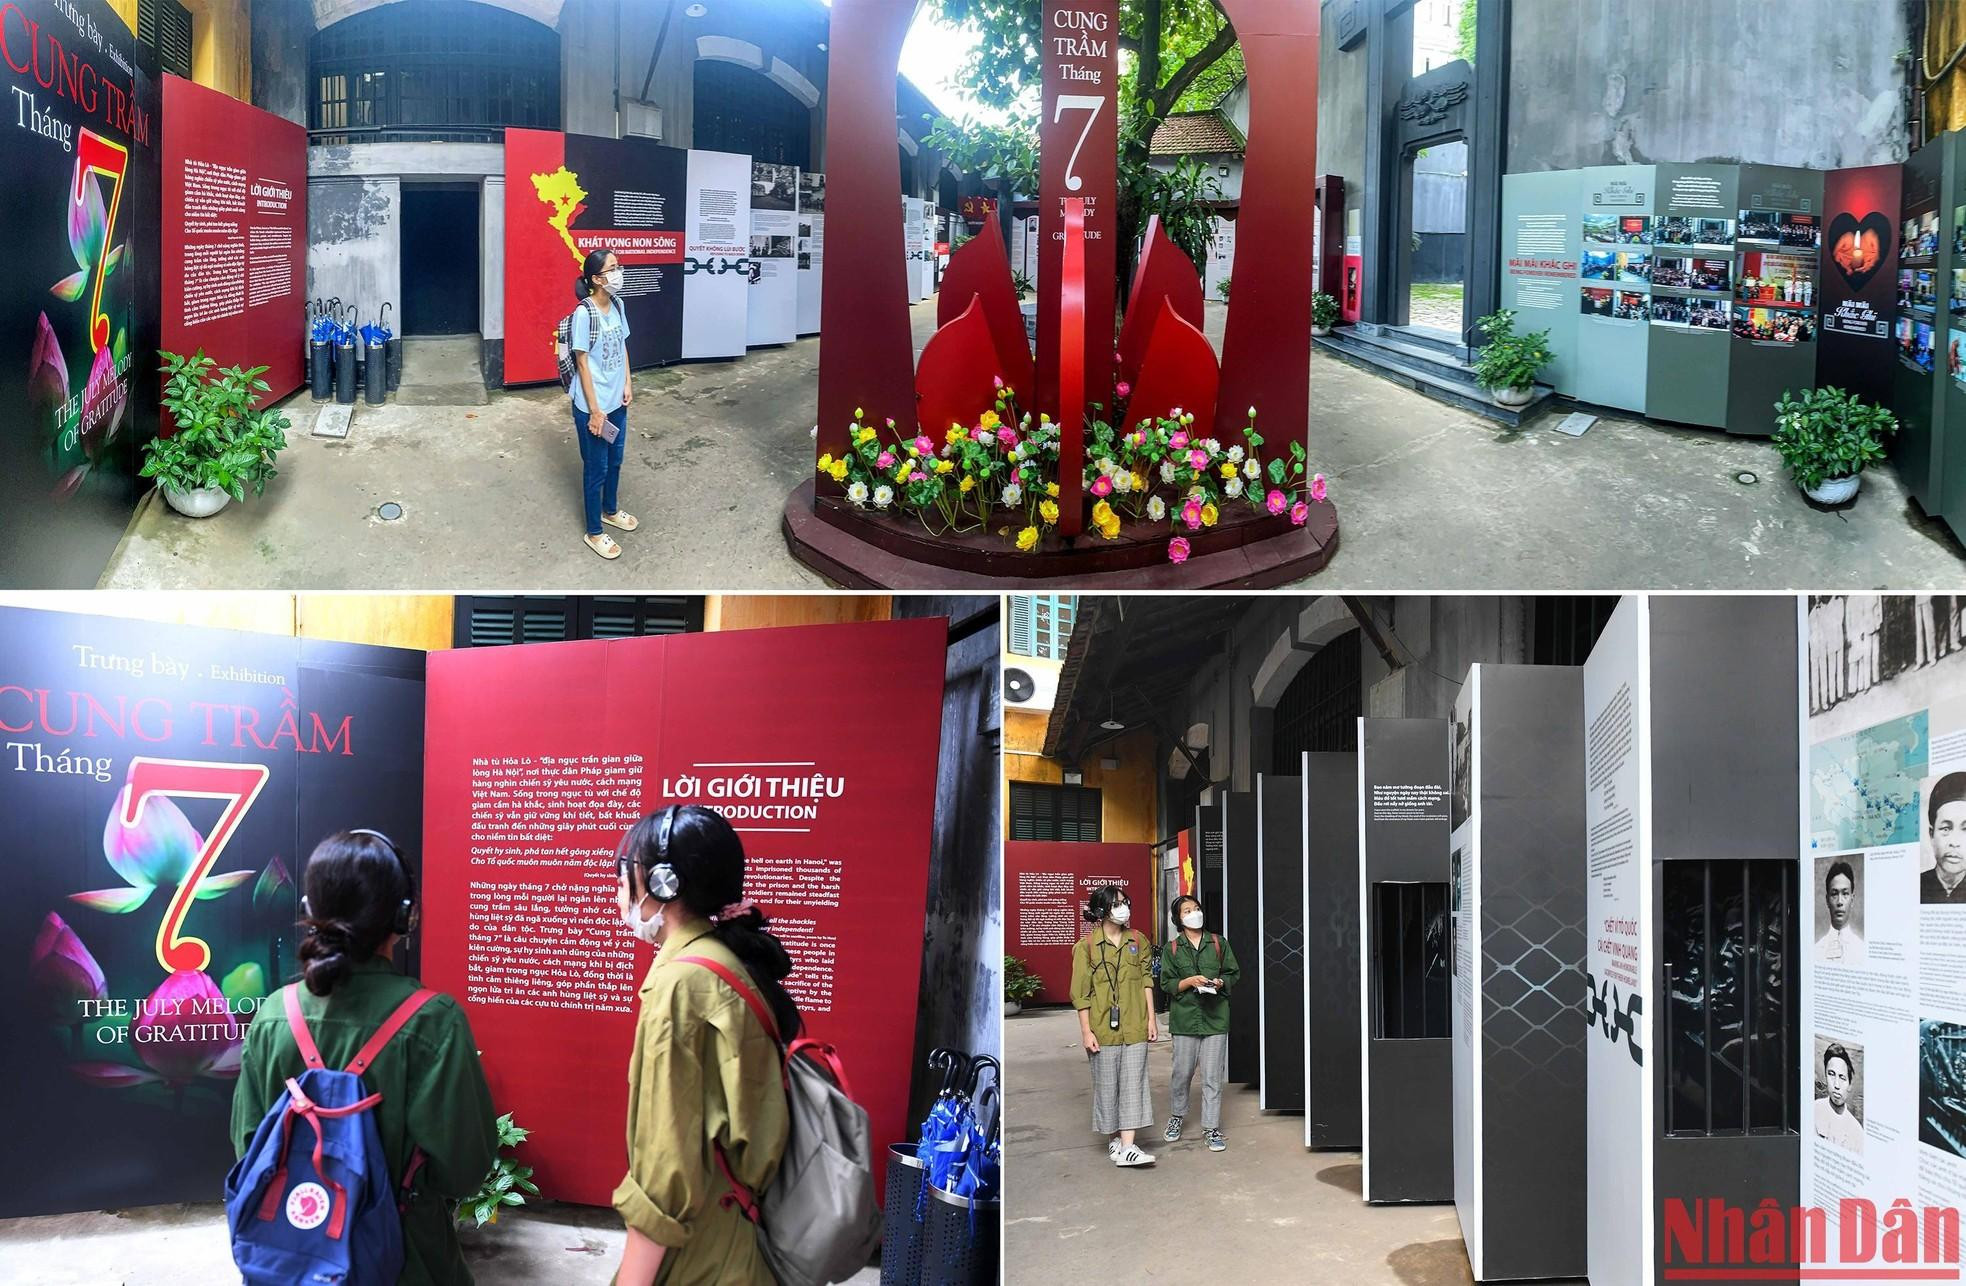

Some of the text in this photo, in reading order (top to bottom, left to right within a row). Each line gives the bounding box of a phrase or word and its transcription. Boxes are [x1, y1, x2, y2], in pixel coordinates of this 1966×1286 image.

[1053, 9, 1108, 32] CUNG
[87, 13, 103, 53] bày
[109, 43, 134, 77] Exhibition
[1053, 30, 1107, 58] TRẦM
[0, 3, 150, 147] CUNG TRẦM
[1059, 64, 1101, 84] Tháng
[12, 85, 72, 152] Tháng
[1054, 94, 1106, 191] 7
[250, 183, 292, 202] LỜI GIỚI THIỆU
[75, 126, 128, 354] 7
[578, 236, 676, 250] KHÁT VỌNG NON SÔNG
[55, 352, 132, 429] THE JULY MELODY
[64, 378, 128, 451] OF GRATITUDE
[73, 644, 286, 686] Trưng bày Exhibition
[0, 685, 354, 756] CUNG TRẦM
[6, 741, 112, 782] Tháng
[472, 757, 489, 765] Nhà
[490, 757, 500, 765] tù
[502, 756, 518, 765] Hỏa
[539, 756, 555, 766] “địa
[557, 757, 578, 765] ngục
[581, 754, 599, 763] trần
[601, 755, 621, 764] gian
[623, 754, 643, 764] giữa
[472, 765, 642, 778] lòng Hà Nội”, nơi thực dân Pháp giam giữ
[471, 777, 642, 788] hàng nghìn chiến sỹ yêu nước, cách mạng
[471, 790, 488, 799] Việt
[512, 789, 533, 799] Sống
[535, 790, 559, 799] trong
[560, 791, 582, 799] ngục
[583, 788, 593, 796] tù
[595, 788, 609, 796] với
[611, 787, 627, 796] chế
[629, 788, 641, 798] độ
[662, 773, 845, 803] LỜI GIỚI THIỆU
[470, 832, 485, 840] cho
[486, 831, 506, 840] niềm
[519, 831, 533, 840] bất
[533, 833, 553, 842] diệt:
[120, 755, 270, 974] 7
[1080, 878, 1129, 887] LỜI GIỚI THIỆU
[468, 953, 634, 971] chiến sỹ yêu nước, cách mạng khi bị địch
[468, 963, 633, 980] bắt, giam trong ngục Hỏa Lò, đồng thời là
[77, 998, 128, 1018] THE
[133, 998, 185, 1020] JULY
[96, 1025, 129, 1044] OF
